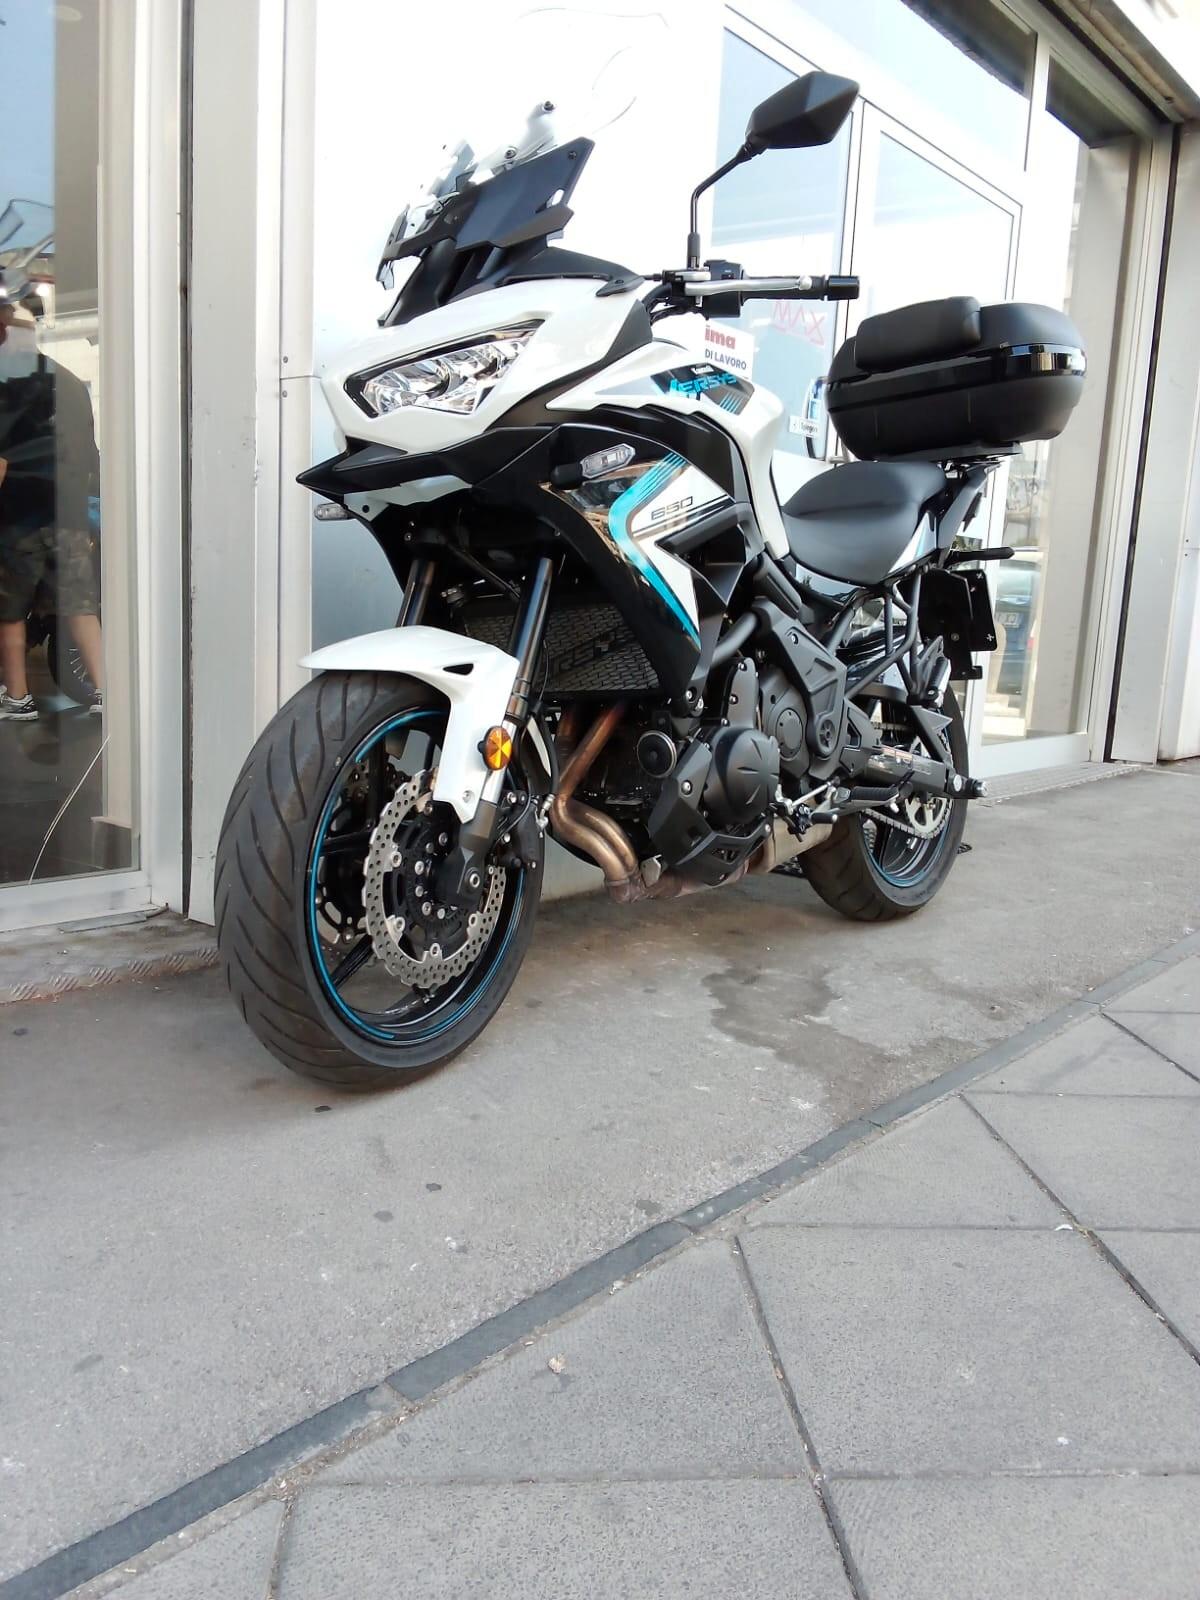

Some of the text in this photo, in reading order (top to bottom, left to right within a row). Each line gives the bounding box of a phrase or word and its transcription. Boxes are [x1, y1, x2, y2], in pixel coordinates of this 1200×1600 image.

[704, 348, 714, 360] DI
[714, 350, 747, 371] LAVORO
[651, 495, 694, 521] 650
